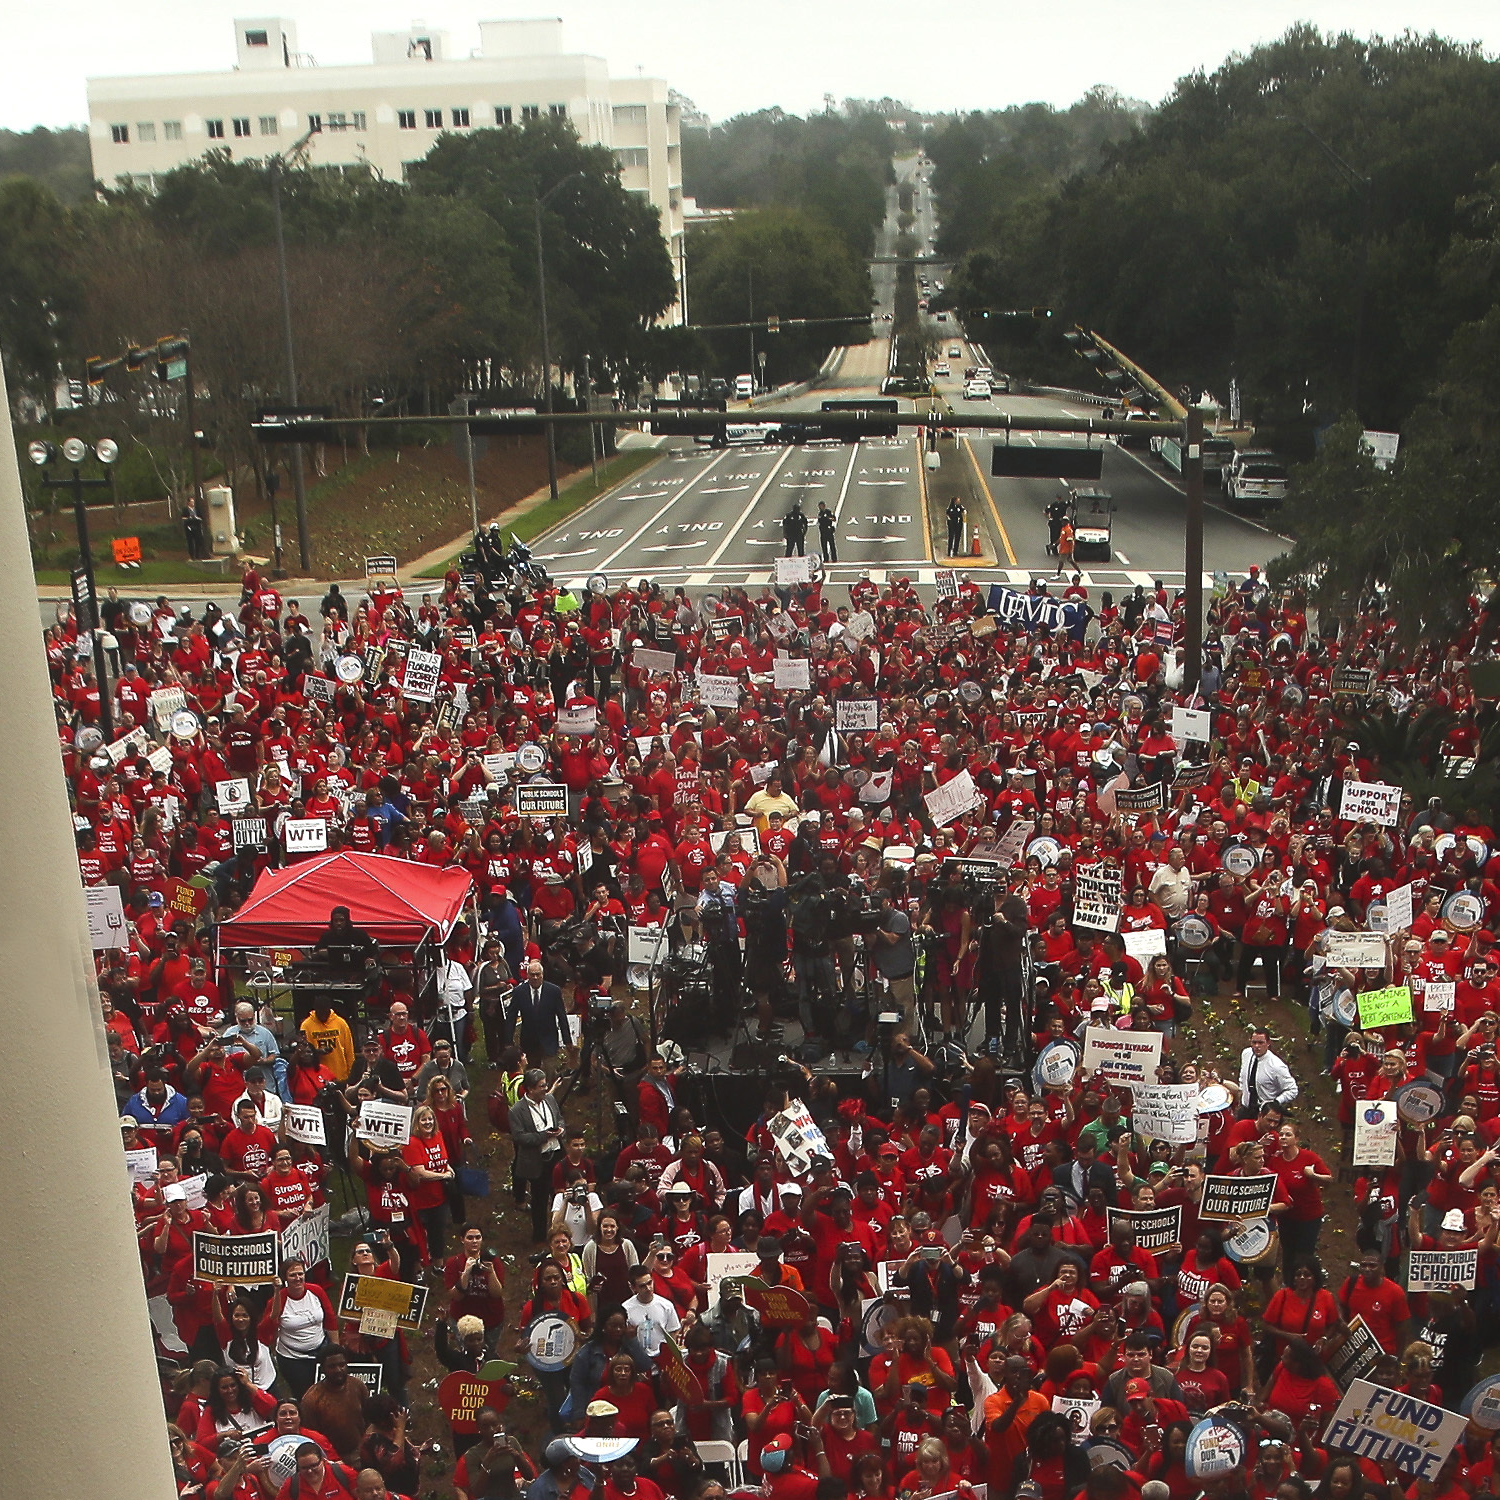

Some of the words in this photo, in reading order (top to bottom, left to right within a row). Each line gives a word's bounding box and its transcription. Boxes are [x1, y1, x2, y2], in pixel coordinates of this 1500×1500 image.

[708, 472, 760, 482] ONLY
[784, 469, 836, 478] ONLY
[631, 478, 684, 490] ONLY
[847, 513, 912, 525] ONLY
[656, 521, 724, 535] ONLY
[554, 528, 624, 543] ONLY
[410, 650, 426, 662] THIS
[429, 654, 440, 664] IS
[675, 766, 699, 780] Fund
[677, 780, 695, 790] our
[521, 790, 539, 798] PUBLIC
[540, 790, 564, 798] SCHOOLS
[673, 791, 699, 805] Future
[1346, 787, 1395, 801] SUPPORT
[521, 800, 536, 810] OUR
[537, 800, 564, 810] FUTURE
[1344, 802, 1391, 818] SCHOOLS
[1361, 799, 1376, 807] OUR
[288, 828, 324, 842] WTF
[1076, 876, 1121, 891] STUDENTS
[176, 885, 196, 898] FUND
[177, 894, 192, 904] OUR
[170, 900, 197, 916] FUTURE
[1361, 988, 1407, 1003] TEACHING
[1362, 1002, 1374, 1012] IS
[1375, 1000, 1389, 1010] NOT
[1092, 1040, 1125, 1050] SCHOOLS
[1125, 1043, 1154, 1053] PRIVATE
[1116, 1063, 1143, 1072] SHOULD
[1161, 1090, 1183, 1100] afford
[290, 1115, 320, 1133] WTF
[364, 1118, 405, 1136] WTF
[274, 1182, 303, 1195] Strong
[1209, 1183, 1239, 1195] PUBLIC
[1239, 1182, 1270, 1196] SCHOOLS
[277, 1193, 305, 1206] Public
[1206, 1199, 1231, 1212] OUR
[1231, 1196, 1267, 1214] FUTURE
[1141, 1216, 1176, 1231] SCHOOLS
[1135, 1230, 1175, 1248] FUTURE
[1235, 1232, 1250, 1247] OUR
[199, 1242, 231, 1256] PUBLIC
[231, 1242, 272, 1257] SCHOOLS
[1411, 1252, 1448, 1265] STRONG
[1448, 1251, 1477, 1263] PUBLIC
[200, 1258, 224, 1276] OUR
[225, 1260, 273, 1277] FUTURE
[1409, 1263, 1476, 1282] SCHOOLS
[760, 1292, 788, 1302] FUND
[768, 1301, 789, 1311] OUR
[766, 1310, 803, 1321] FUTURE
[1349, 1326, 1369, 1350] OUR
[536, 1338, 545, 1357] FUND
[459, 1383, 489, 1397] FUND
[461, 1397, 485, 1409] OUR
[1366, 1387, 1444, 1432] FUND
[1374, 1412, 1417, 1442] OUR
[898, 1430, 918, 1442] FUND
[898, 1441, 914, 1453] OUR
[1200, 1438, 1219, 1451] FUND
[1327, 1419, 1443, 1482] FUTURE
[280, 1453, 297, 1471] OUR
[1200, 1450, 1216, 1462] OUR
[1201, 1461, 1230, 1473] FUTURE
